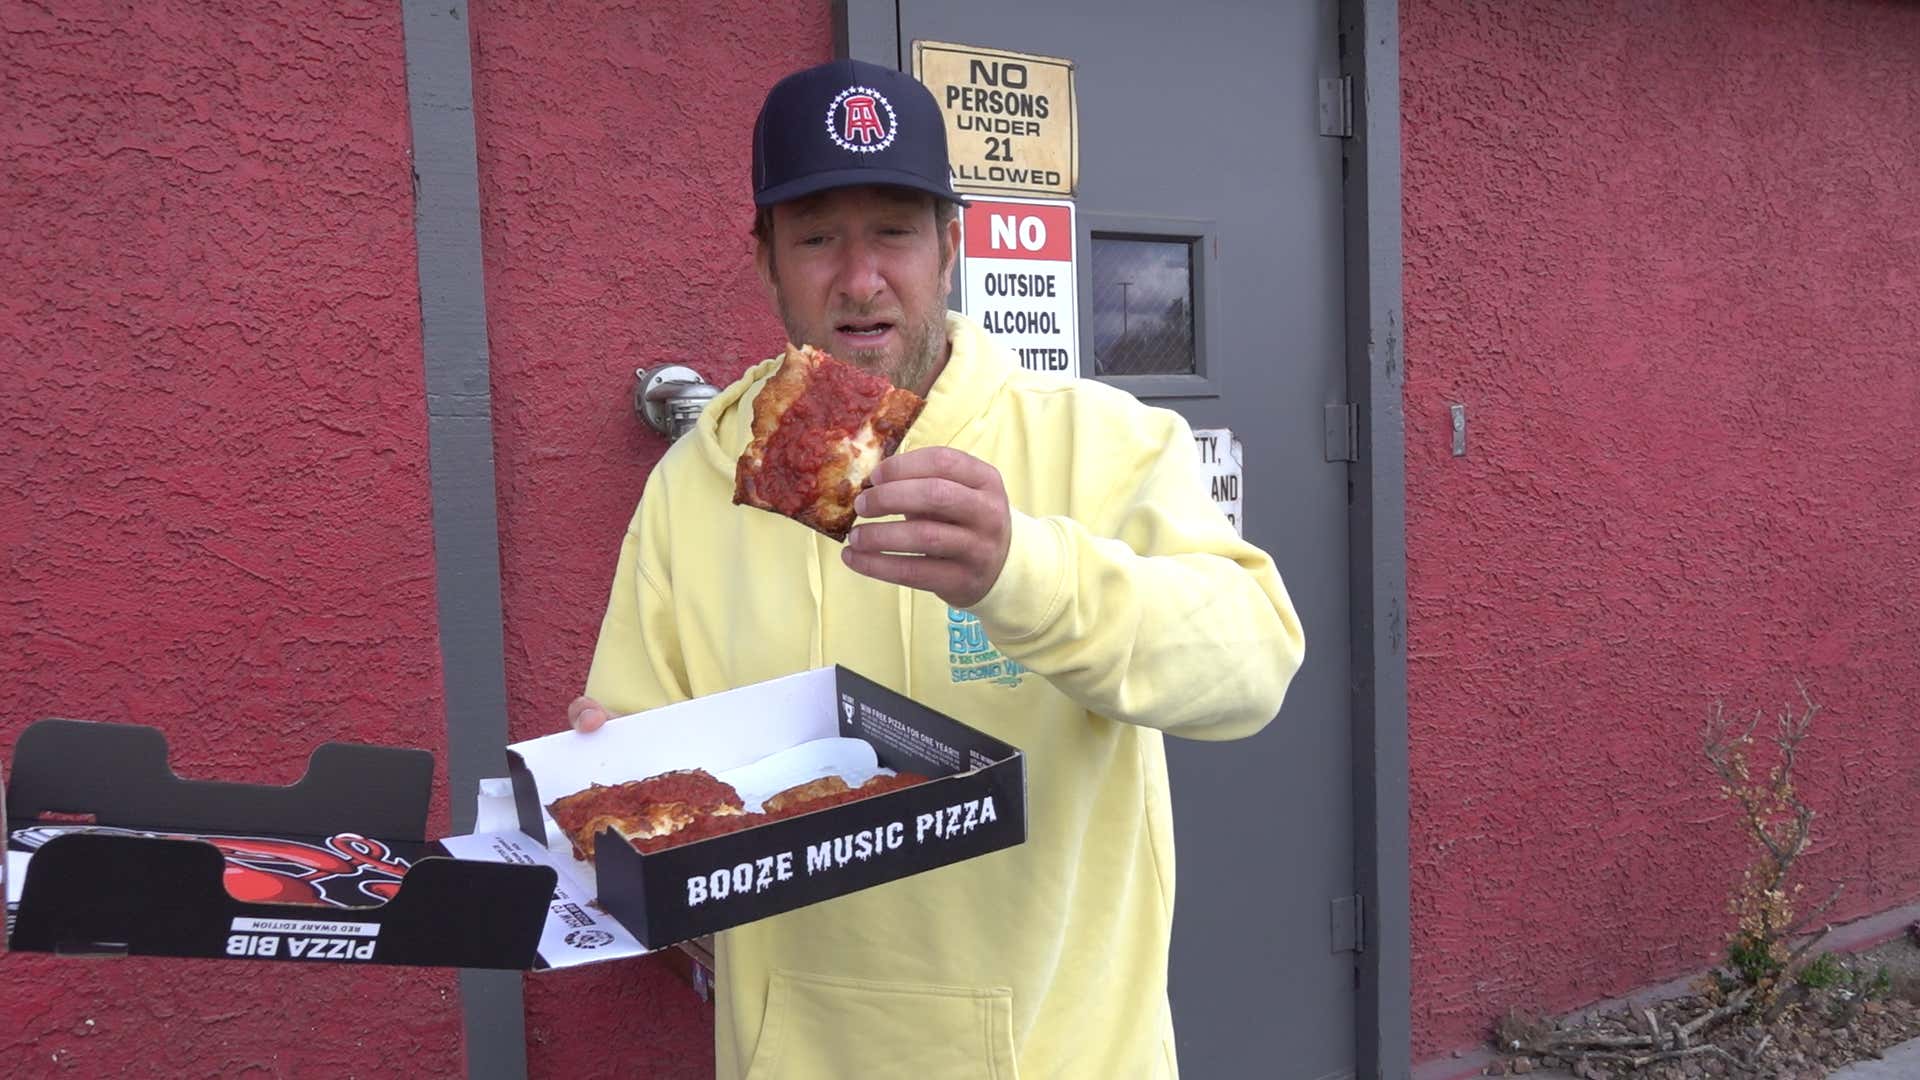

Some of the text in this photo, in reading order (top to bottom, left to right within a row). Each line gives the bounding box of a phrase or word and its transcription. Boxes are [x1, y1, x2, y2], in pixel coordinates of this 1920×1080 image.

[970, 60, 1027, 89] NO
[946, 85, 1049, 119] PERSONS
[957, 115, 1040, 136] UNDER
[984, 137, 1014, 161] 21
[990, 214, 1047, 251] NO
[985, 273, 1056, 298] OUTSIDE
[983, 310, 1061, 334] ALCOHOL
[1195, 436, 1221, 465] TY,
[1211, 475, 1238, 502] AND
[872, 708, 886, 721] FREE
[888, 716, 906, 732] PIZZA
[907, 726, 919, 740] FOR
[920, 733, 934, 747] ONE
[687, 795, 998, 907] BOOZE MUSIC PIZZA
[252, 921, 361, 933] RED DWARF EDITION
[225, 934, 376, 960] PIZZA BIB
